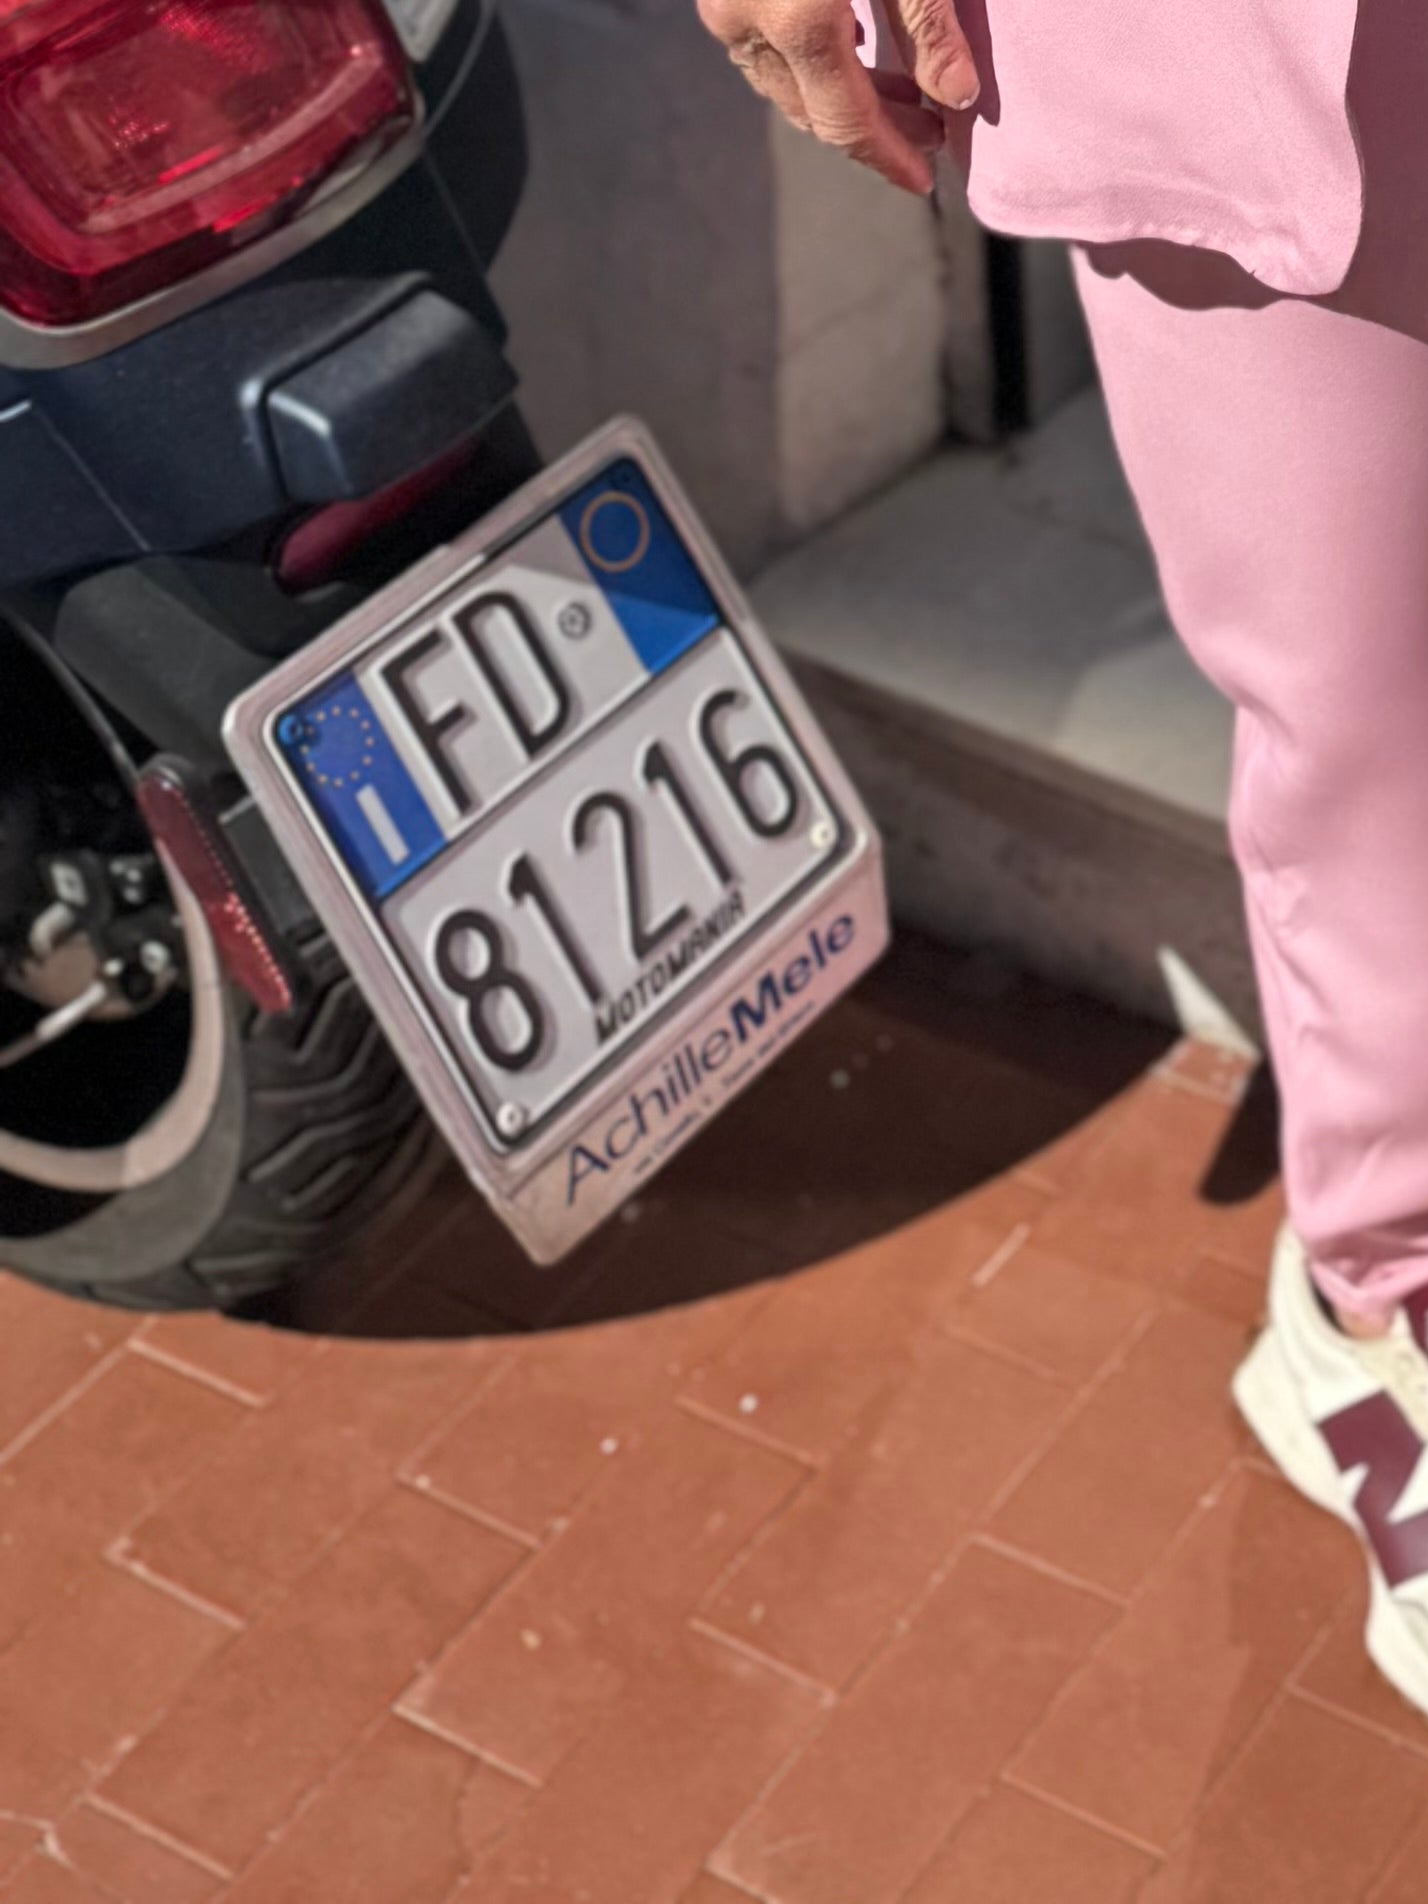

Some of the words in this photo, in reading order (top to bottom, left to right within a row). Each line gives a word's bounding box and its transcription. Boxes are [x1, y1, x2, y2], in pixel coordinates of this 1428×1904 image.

[379, 589, 569, 816] FD
[434, 688, 798, 1073] 81216
[593, 889, 747, 1046] MOTOMANIA
[566, 913, 855, 1206] AchilleMele
